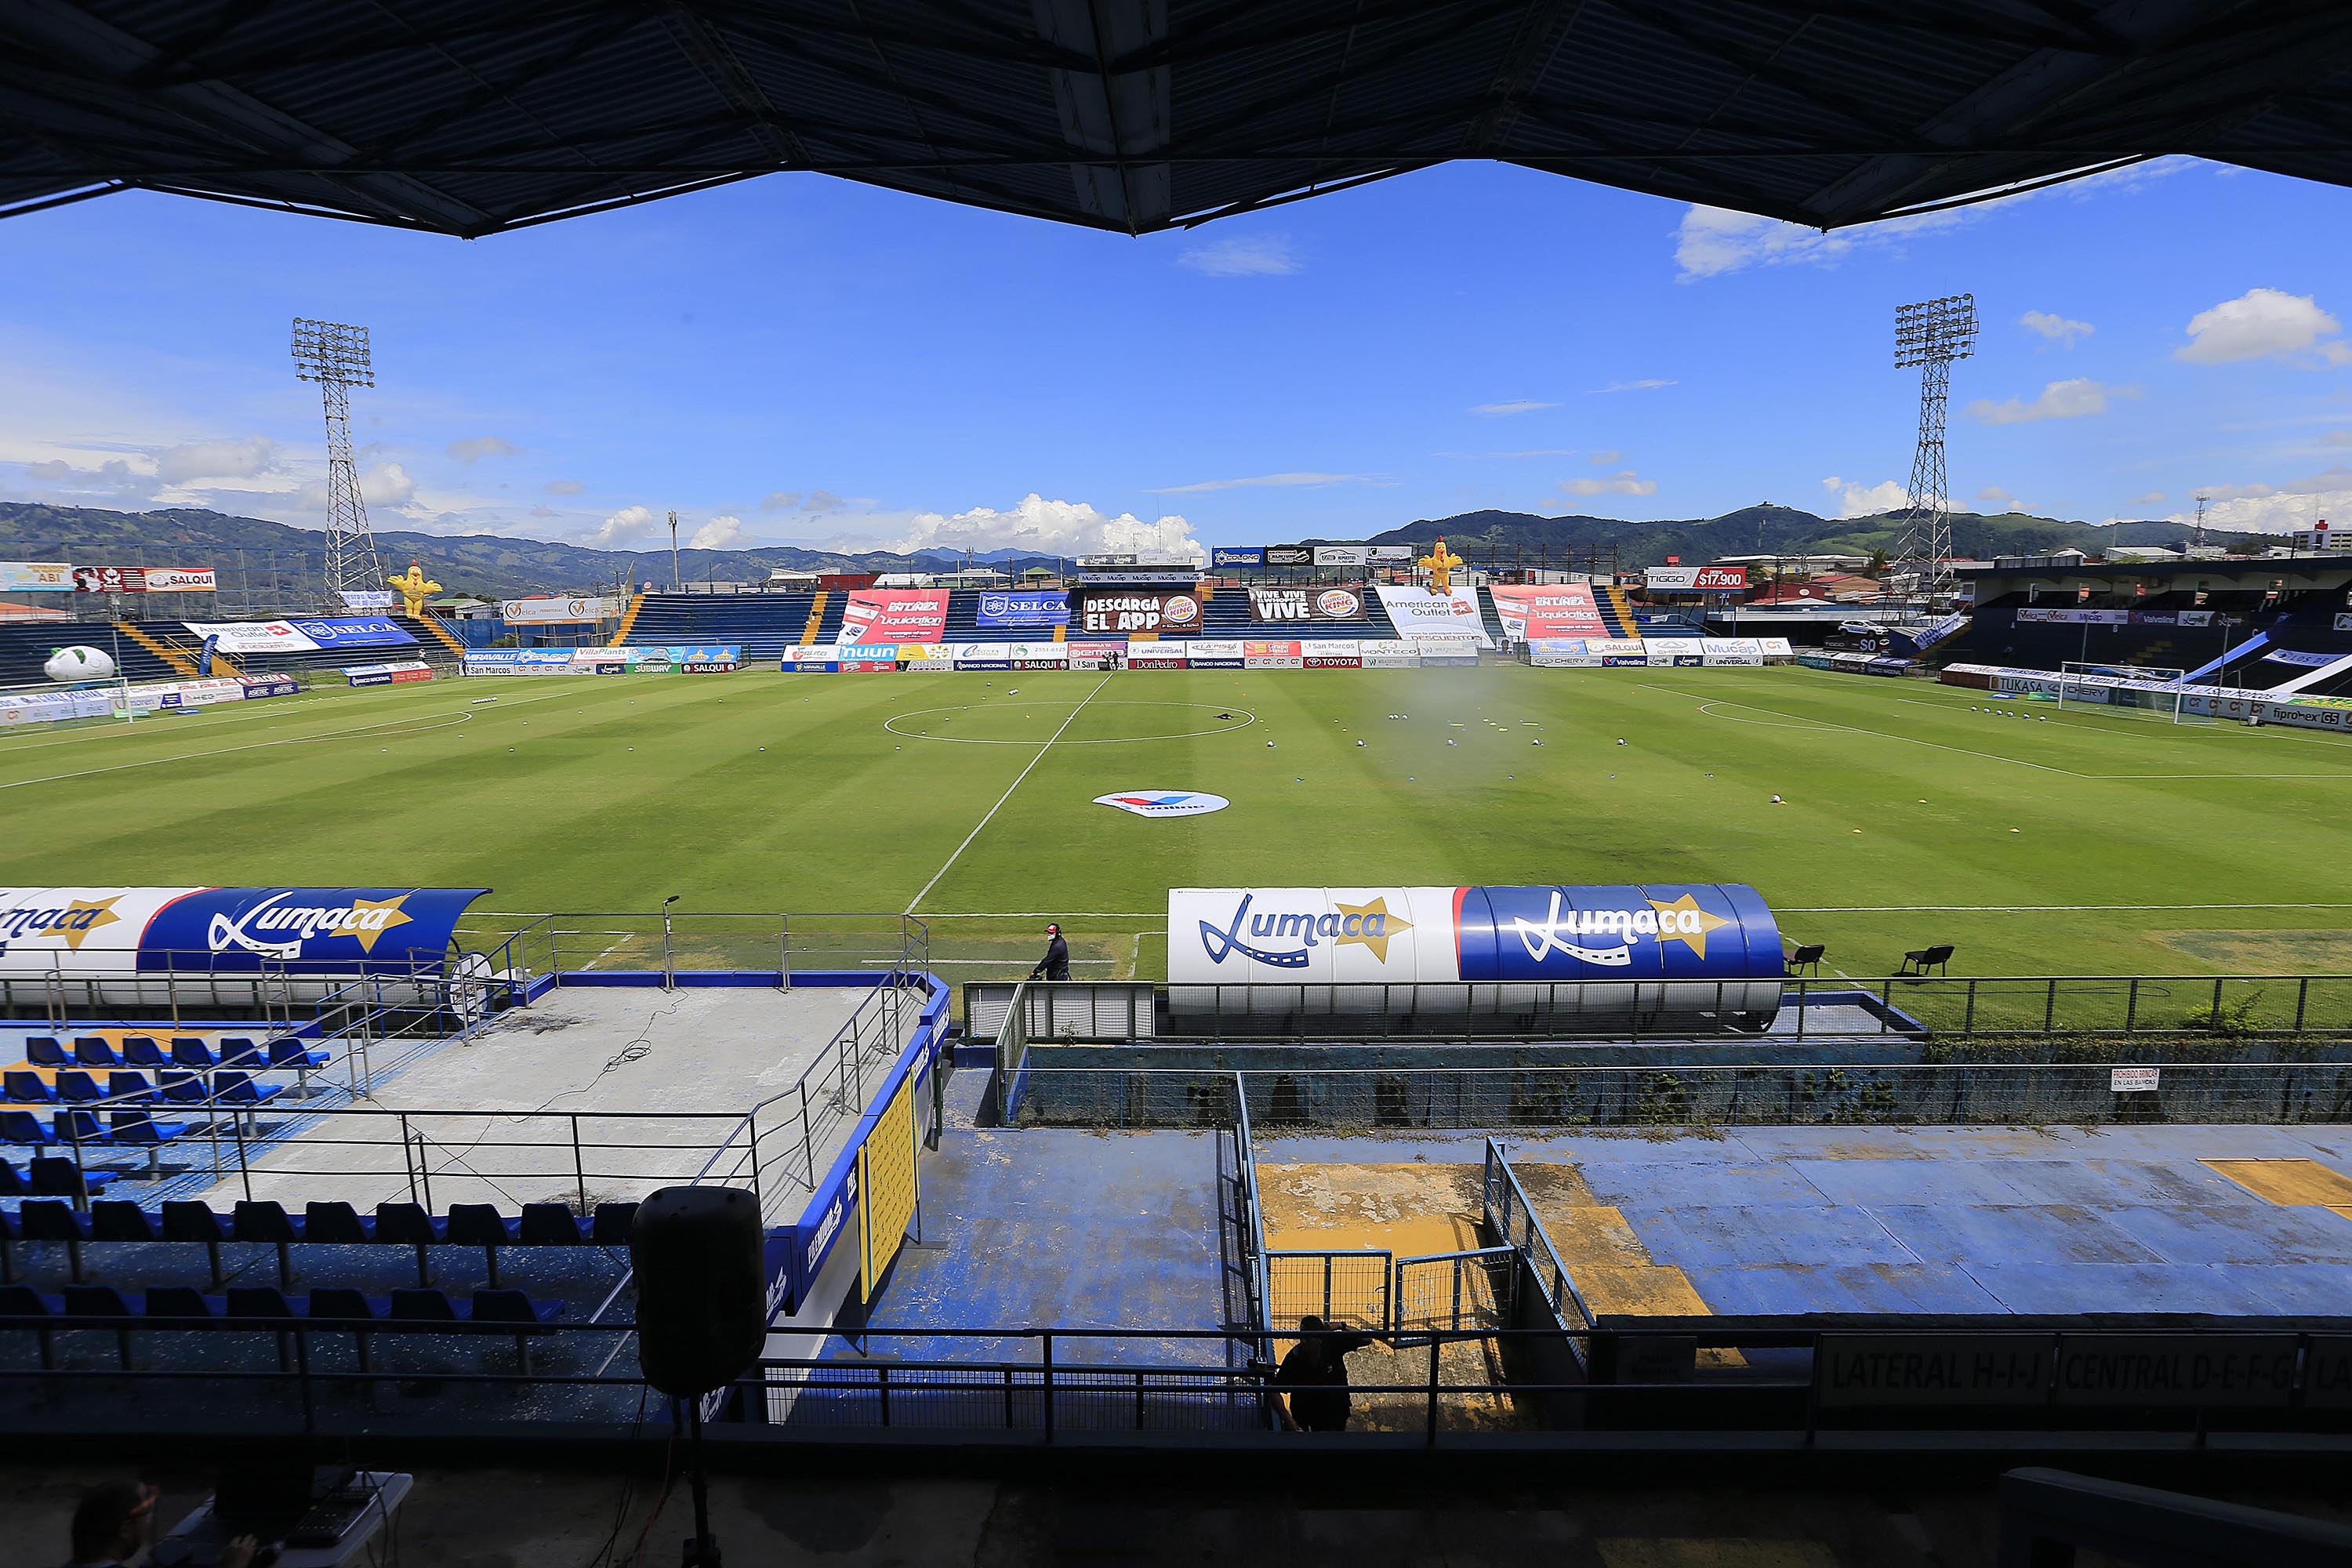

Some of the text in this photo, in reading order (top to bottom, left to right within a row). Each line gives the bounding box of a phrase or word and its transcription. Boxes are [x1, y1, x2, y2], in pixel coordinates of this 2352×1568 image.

[38, 573, 61, 583] ABI
[169, 575, 212, 585] SALQUI
[1699, 573, 1741, 586] $17.900
[1087, 596, 1161, 612] DESCARGÁ
[1323, 594, 1351, 605] BURGER
[1324, 599, 1354, 611] KING
[1008, 600, 1068, 611] SELCA
[1168, 601, 1192, 611] BURGER
[1257, 602, 1311, 619] VIVE
[1169, 607, 1193, 618] KING
[1411, 608, 1450, 616] Outlet
[1532, 609, 1597, 620] Liquidation
[880, 615, 942, 626] Liquidation
[1086, 612, 1160, 630] EL APP
[2143, 615, 2176, 624] Valvoline
[199, 624, 264, 633] American
[332, 622, 401, 634] SELCA
[230, 630, 272, 639] Outlet
[841, 645, 895, 659] nuun
[1706, 643, 1757, 655] Mucap
[1081, 660, 1096, 669] San
[1136, 659, 1178, 669] DonPedro
[2291, 654, 2329, 665] LOS DE
[633, 664, 673, 673] SUBWAY
[693, 663, 725, 673] SALQUI
[250, 673, 281, 684] SALQUI
[129, 684, 170, 693] CHERY
[274, 685, 295, 694] ASETEC
[2000, 677, 2043, 693] TUKASA
[248, 688, 270, 697] ASETEC
[2067, 687, 2107, 698] CHERY
[2237, 690, 2277, 700] Marcos
[2322, 713, 2339, 724] G5
[208, 891, 395, 960] Lumaca
[1200, 892, 1386, 967] Lumaca
[1514, 890, 1702, 967] Lumaca
[2113, 1069, 2158, 1079] PROHIBIDO BRINCAR
[1833, 1352, 2041, 1390] LATERAL H-I-J
[2065, 1353, 2294, 1390] CENTRAL D-E-F-G
